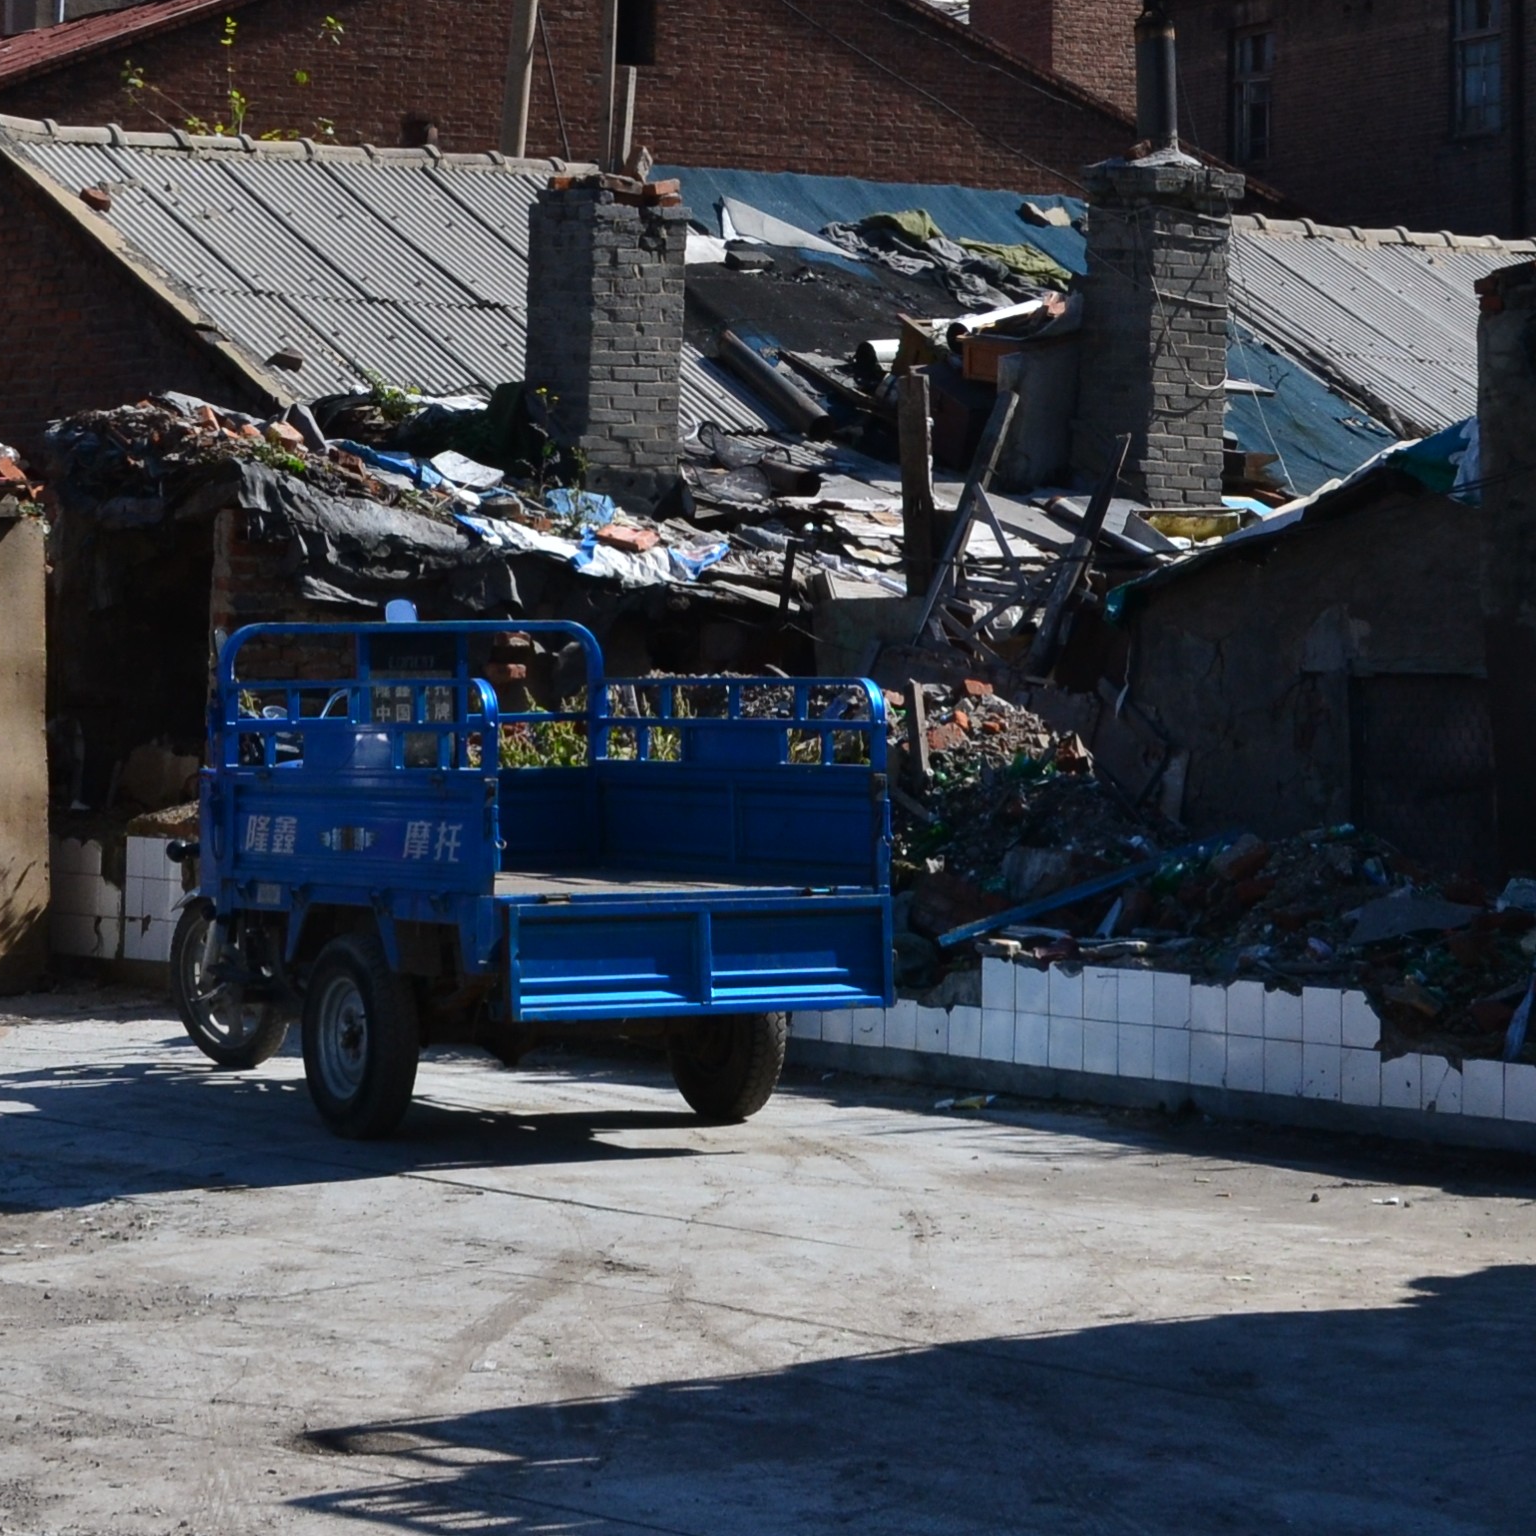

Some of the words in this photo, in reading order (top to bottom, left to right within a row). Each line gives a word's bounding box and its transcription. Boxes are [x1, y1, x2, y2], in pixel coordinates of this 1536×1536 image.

[376, 703, 450, 722] 中国牌
[245, 815, 298, 854] 隆鑫
[402, 820, 463, 862] 摩托
